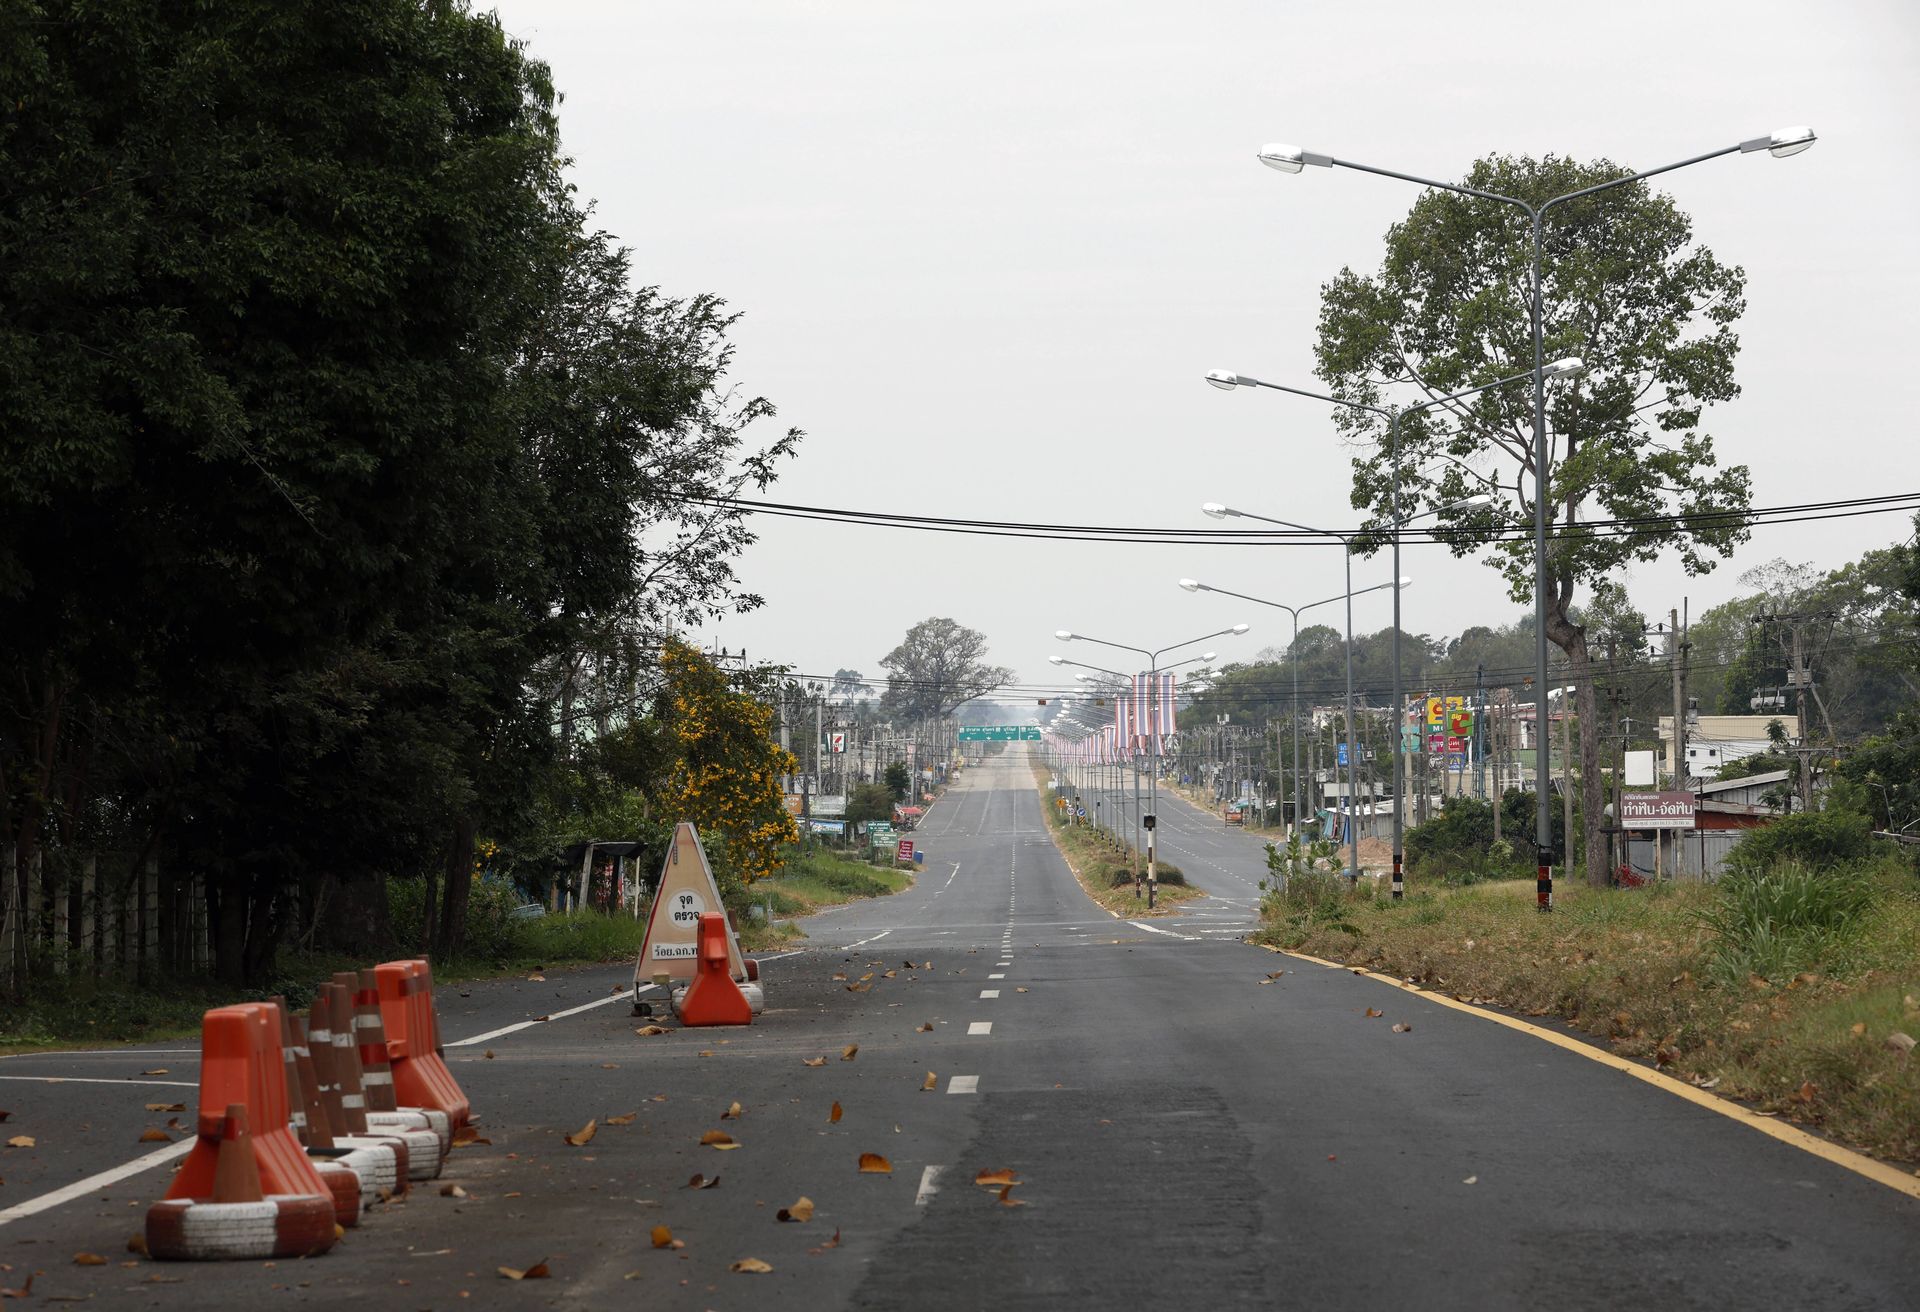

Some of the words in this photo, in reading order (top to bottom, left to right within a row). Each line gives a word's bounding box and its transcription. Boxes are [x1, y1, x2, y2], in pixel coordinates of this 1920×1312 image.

[1451, 713, 1462, 721] Big
[1623, 801, 1693, 816] ทำฟัน-จัดฟัน
[679, 895, 693, 909] จุด
[674, 911, 700, 921] ตรวจ
